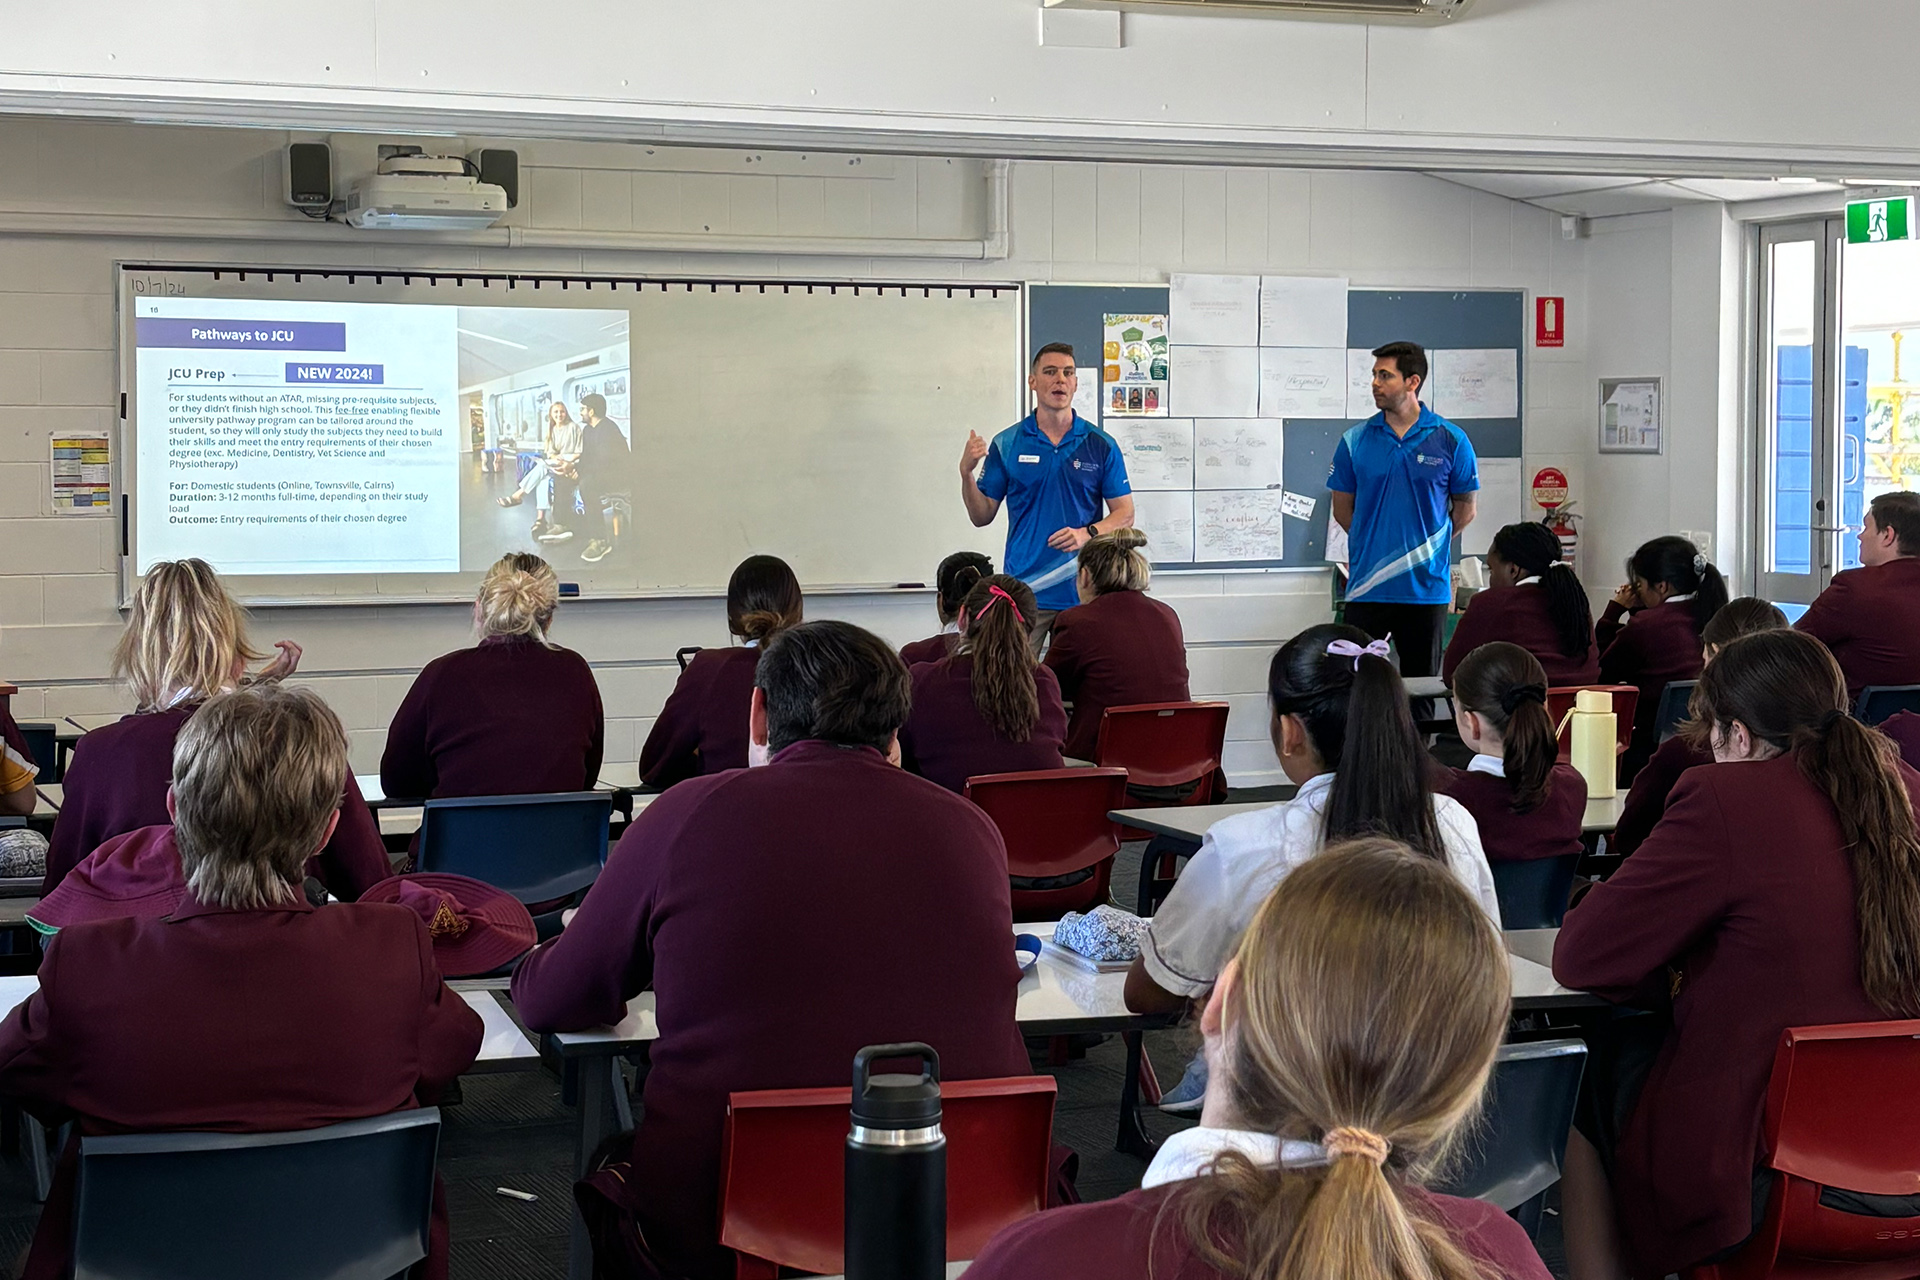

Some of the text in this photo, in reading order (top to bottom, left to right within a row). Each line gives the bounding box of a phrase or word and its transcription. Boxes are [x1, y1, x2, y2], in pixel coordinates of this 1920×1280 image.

[131, 276, 186, 297] 10/7/24
[191, 328, 294, 342] Pathways to JCU
[167, 368, 225, 382] JCU Prep
[297, 366, 372, 380] NEW 2024!
[168, 393, 184, 402] For
[186, 394, 227, 402] students
[229, 394, 264, 403] without
[279, 395, 304, 403] ATAR,
[306, 395, 340, 405] missing
[342, 396, 397, 405] pre-requisite
[399, 396, 437, 406] subjects,
[181, 405, 202, 415] they
[204, 405, 230, 413] didn't
[232, 405, 257, 413] finish
[259, 405, 279, 415] high
[281, 405, 313, 414] school.
[315, 406, 333, 414] This
[335, 406, 369, 415] fee-free
[371, 407, 408, 416] enabling
[410, 407, 441, 415] flexible
[169, 416, 413, 426] university pathway program can be tailored around the
[169, 427, 207, 435] student,
[223, 427, 243, 437] they
[245, 427, 260, 435] will
[262, 427, 281, 437] only
[283, 427, 308, 437] study
[310, 427, 325, 435] the
[327, 428, 363, 437] subjects
[365, 428, 384, 438] they
[386, 428, 408, 436] need
[421, 428, 442, 436] build
[169, 438, 432, 448] their skills and meet the entry requirements of their chosen
[169, 448, 385, 459] degree (exc. Medicine, Dentistry, Vet Science and
[169, 460, 239, 470] Physiotherapy)
[169, 481, 395, 491] For: Domestic students (Online, Townsville, Cairns)
[169, 493, 217, 502] Duration:
[218, 493, 239, 501] 3-12
[241, 493, 276, 501] months
[278, 493, 317, 502] full-time,
[320, 492, 367, 503] depending
[382, 493, 402, 501] their
[404, 493, 429, 503] study
[169, 505, 190, 513] load
[169, 514, 407, 526] Outcome: Entry requirements of their chosen degree
